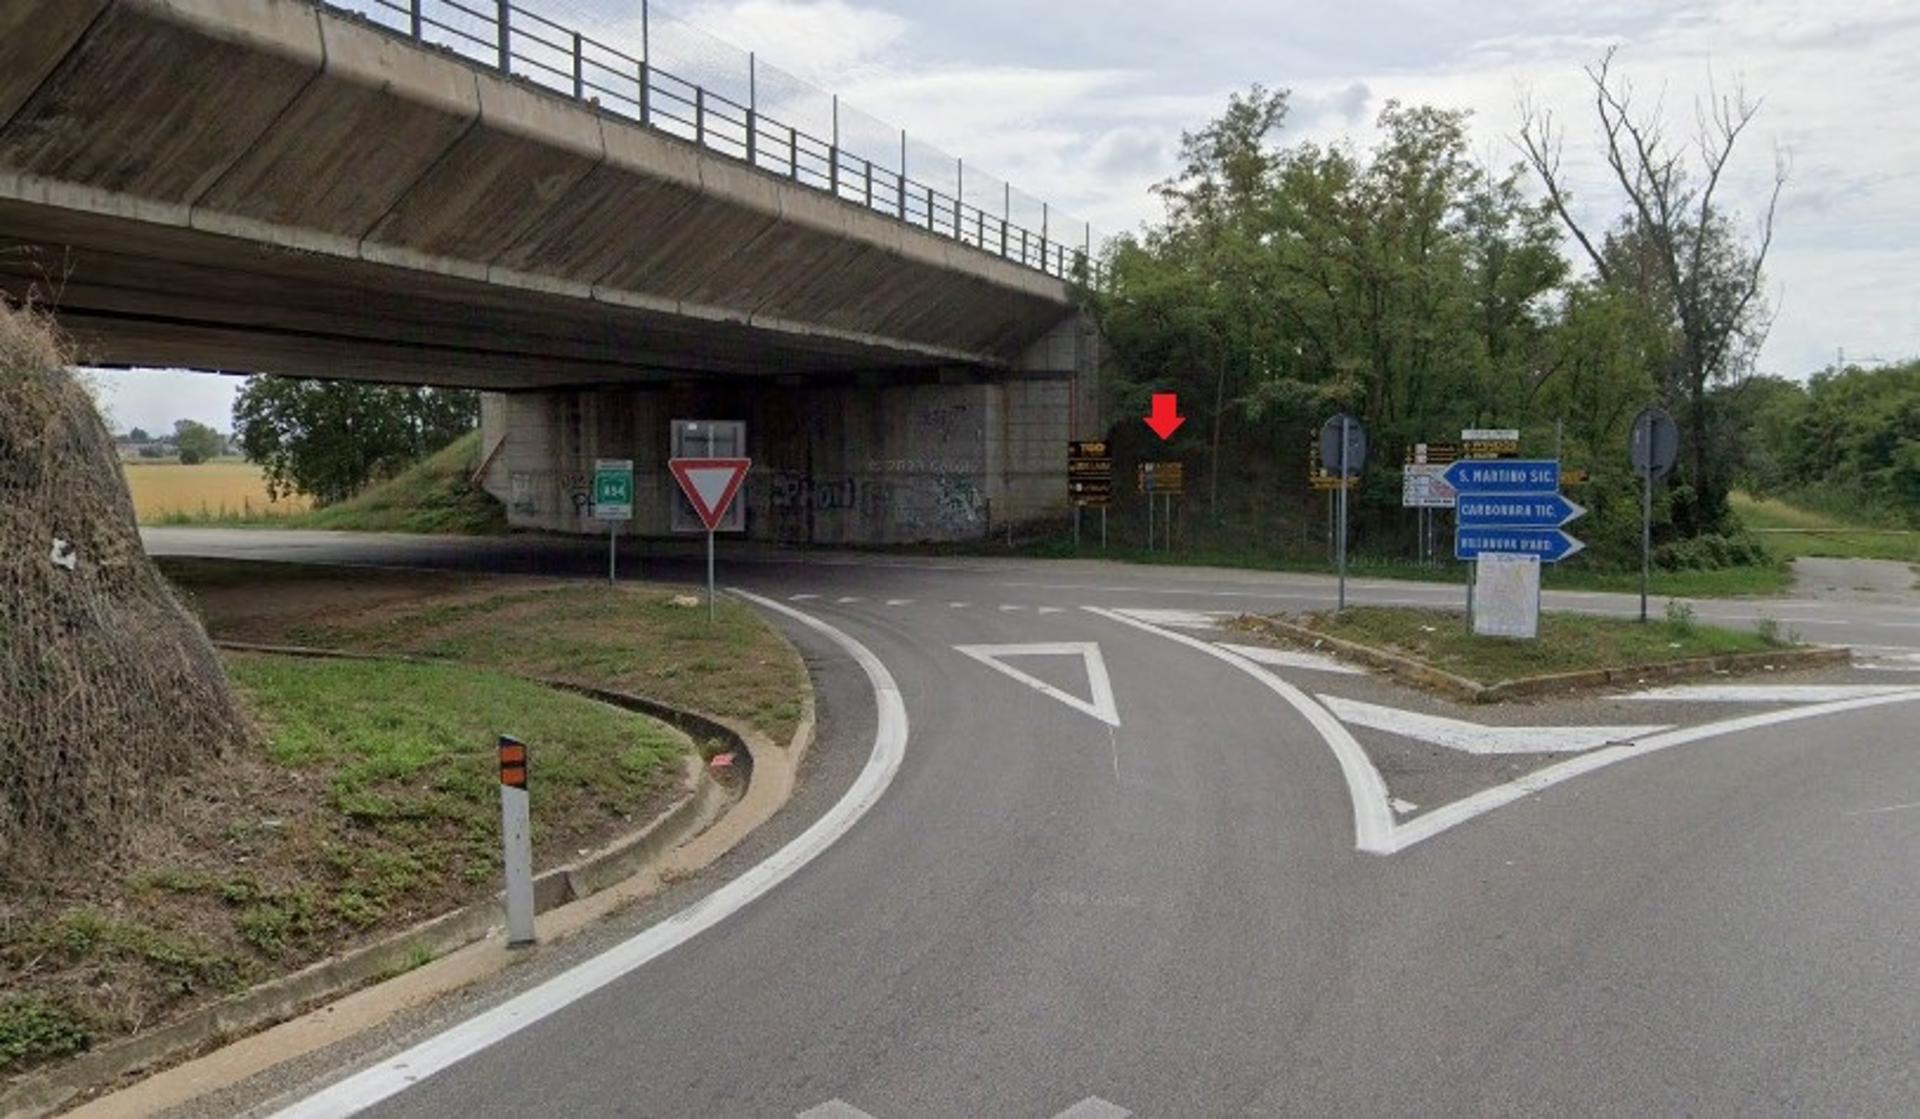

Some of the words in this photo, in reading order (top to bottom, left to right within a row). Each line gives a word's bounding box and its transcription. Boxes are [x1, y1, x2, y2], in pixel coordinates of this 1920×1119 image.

[1459, 469, 1470, 482] S.
[1473, 469, 1527, 483] MARTINO
[1530, 470, 1555, 483] SIC.
[1461, 504, 1531, 516] CARBONARA
[1535, 505, 1557, 517] TIC.
